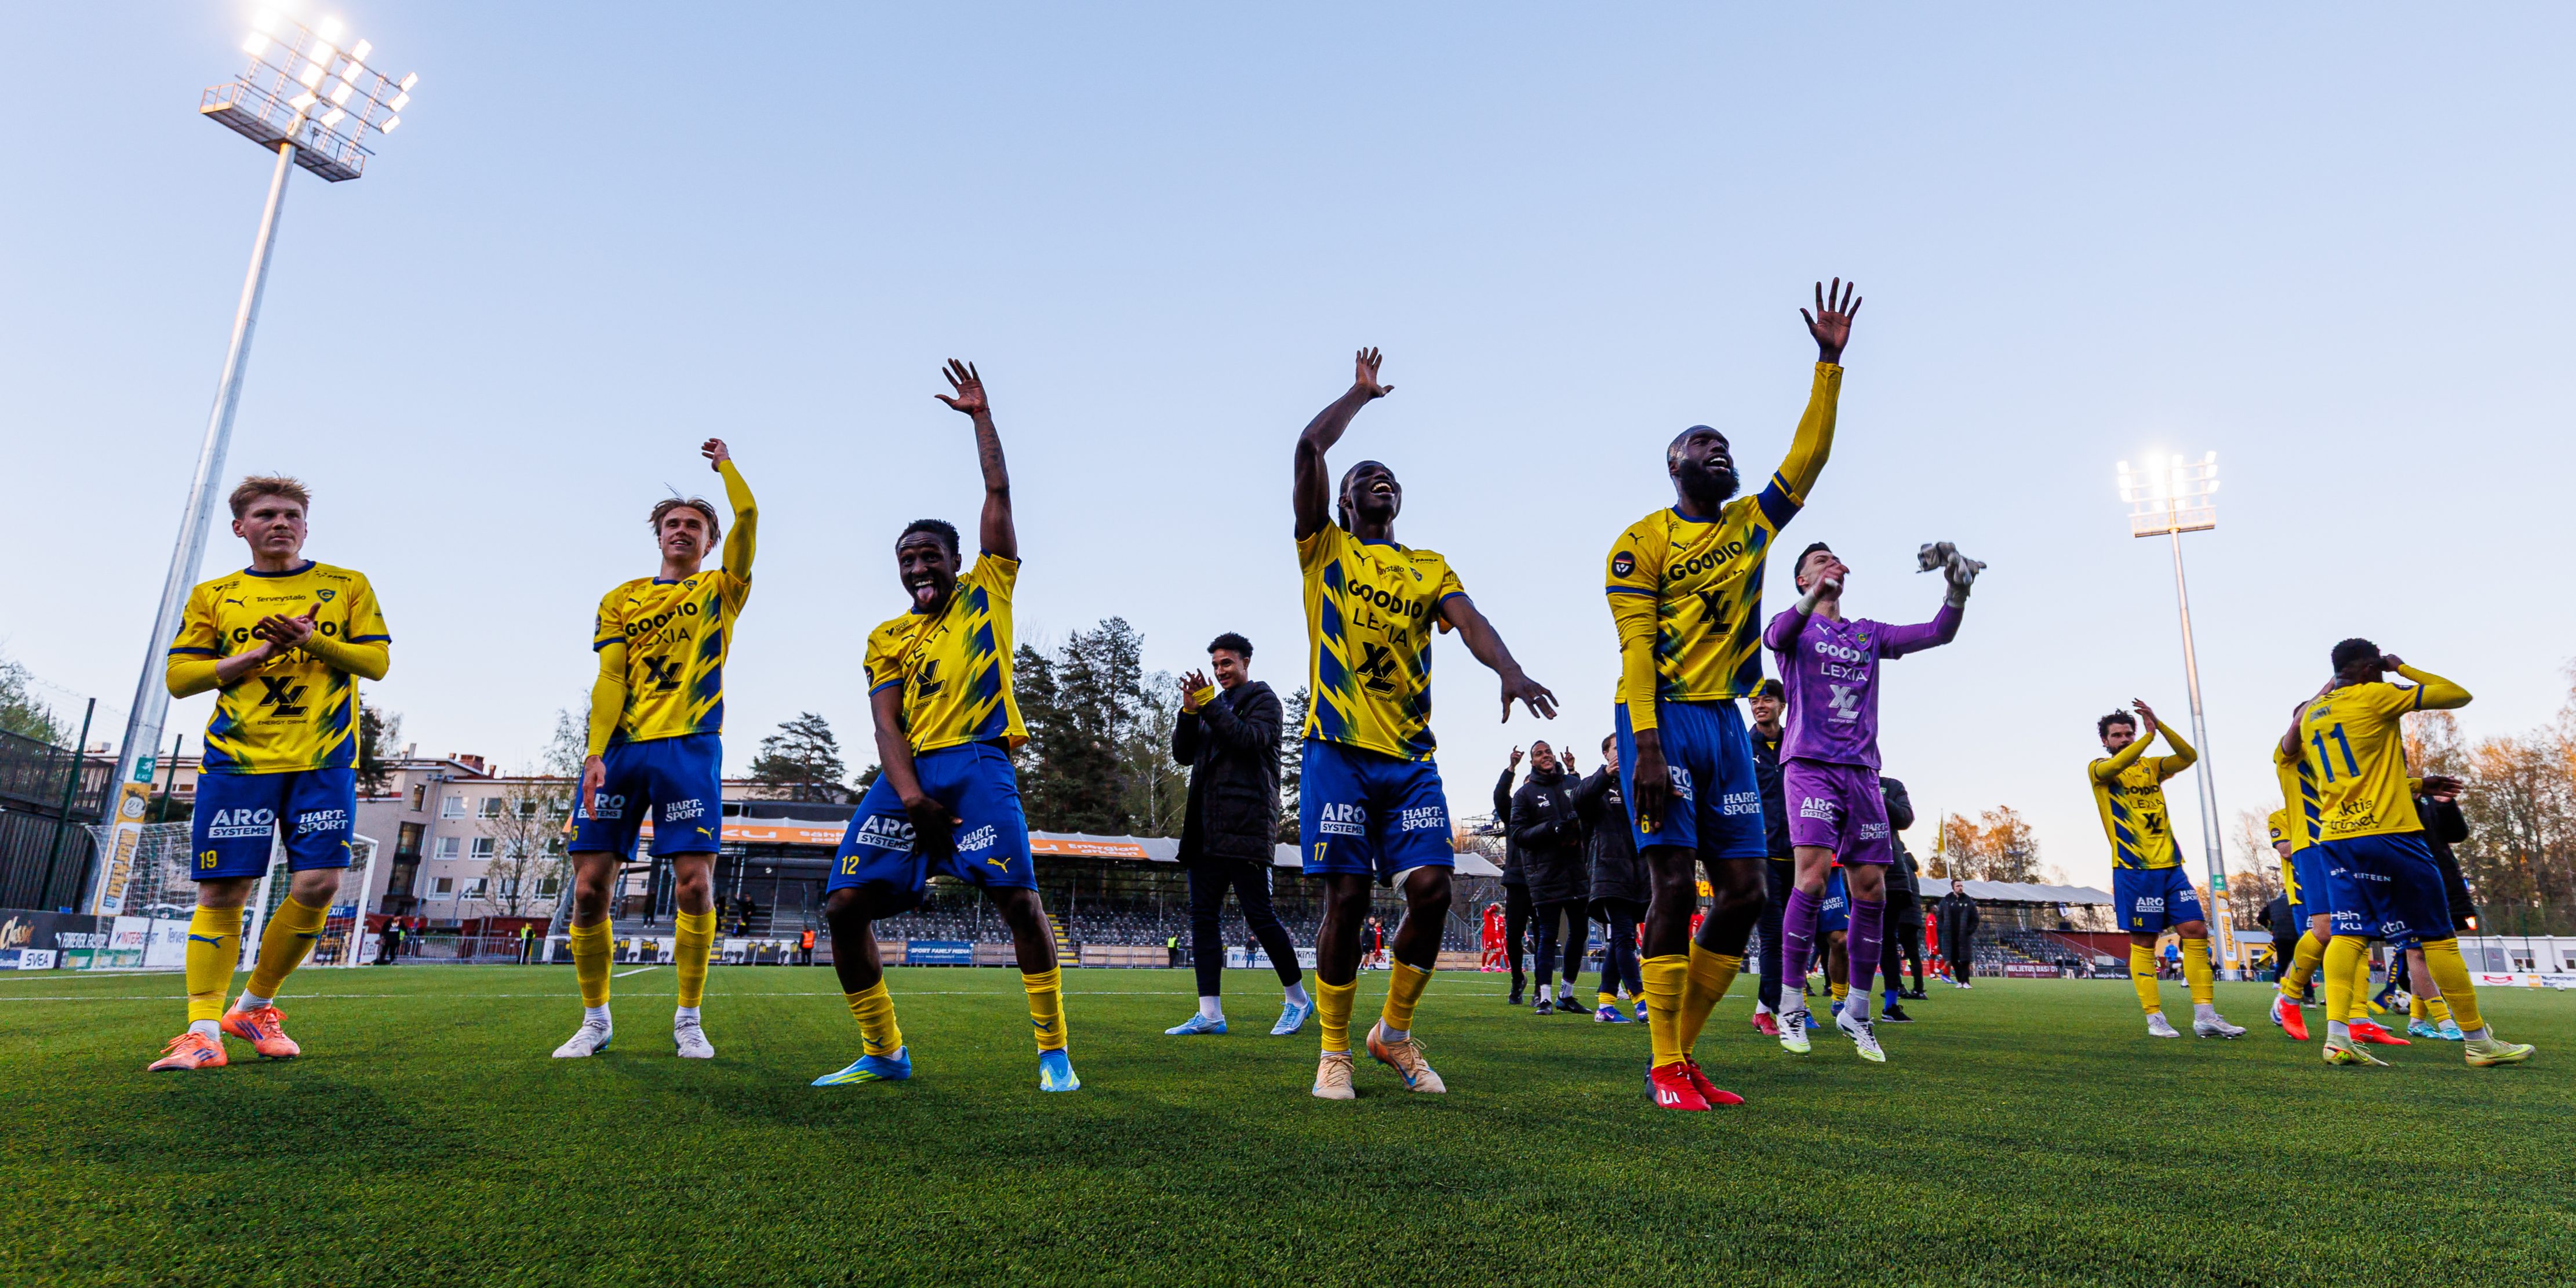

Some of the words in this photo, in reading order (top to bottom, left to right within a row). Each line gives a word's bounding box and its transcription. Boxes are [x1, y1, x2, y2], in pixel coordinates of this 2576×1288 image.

[1668, 541, 1744, 581] GOODIO
[1348, 578, 1423, 620] GOODIO
[1815, 641, 1871, 663] GOODIO
[642, 655, 683, 692] XL
[1821, 662, 1868, 682] LEXIA
[258, 676, 308, 718] XL
[1828, 684, 1858, 719] XL
[912, 700, 932, 711] NERGY
[2311, 723, 2361, 783] 11
[1668, 766, 1691, 787] RO
[580, 794, 625, 809] RO
[667, 799, 703, 810] HART-
[1723, 792, 1758, 805] HART-
[300, 810, 348, 823] HART-
[666, 808, 704, 821] SPORT
[1321, 803, 1366, 824] ARO
[1402, 807, 1443, 821] HART-
[1723, 802, 1760, 816] SPORT
[210, 809, 275, 825] ARO
[1402, 817, 1445, 832] SPORT
[1641, 814, 1649, 834] 6
[2142, 813, 2165, 835] XL
[212, 827, 268, 836] SYSTEMS
[298, 818, 348, 833] SPORT
[1323, 823, 1363, 834] SYSTEMS
[1861, 823, 1888, 831] HART-
[861, 834, 910, 849] SYSTEMS
[962, 825, 995, 843] HART-
[1860, 831, 1889, 840] SPORT
[957, 834, 997, 853] SPORT
[1314, 842, 1327, 861] 17
[199, 850, 217, 869] 19
[842, 856, 859, 875] 12
[1822, 901, 1844, 911] SPORT
[2137, 897, 2164, 906] ARO
[2133, 918, 2143, 927] 14
[26, 953, 48, 966] SVEA
